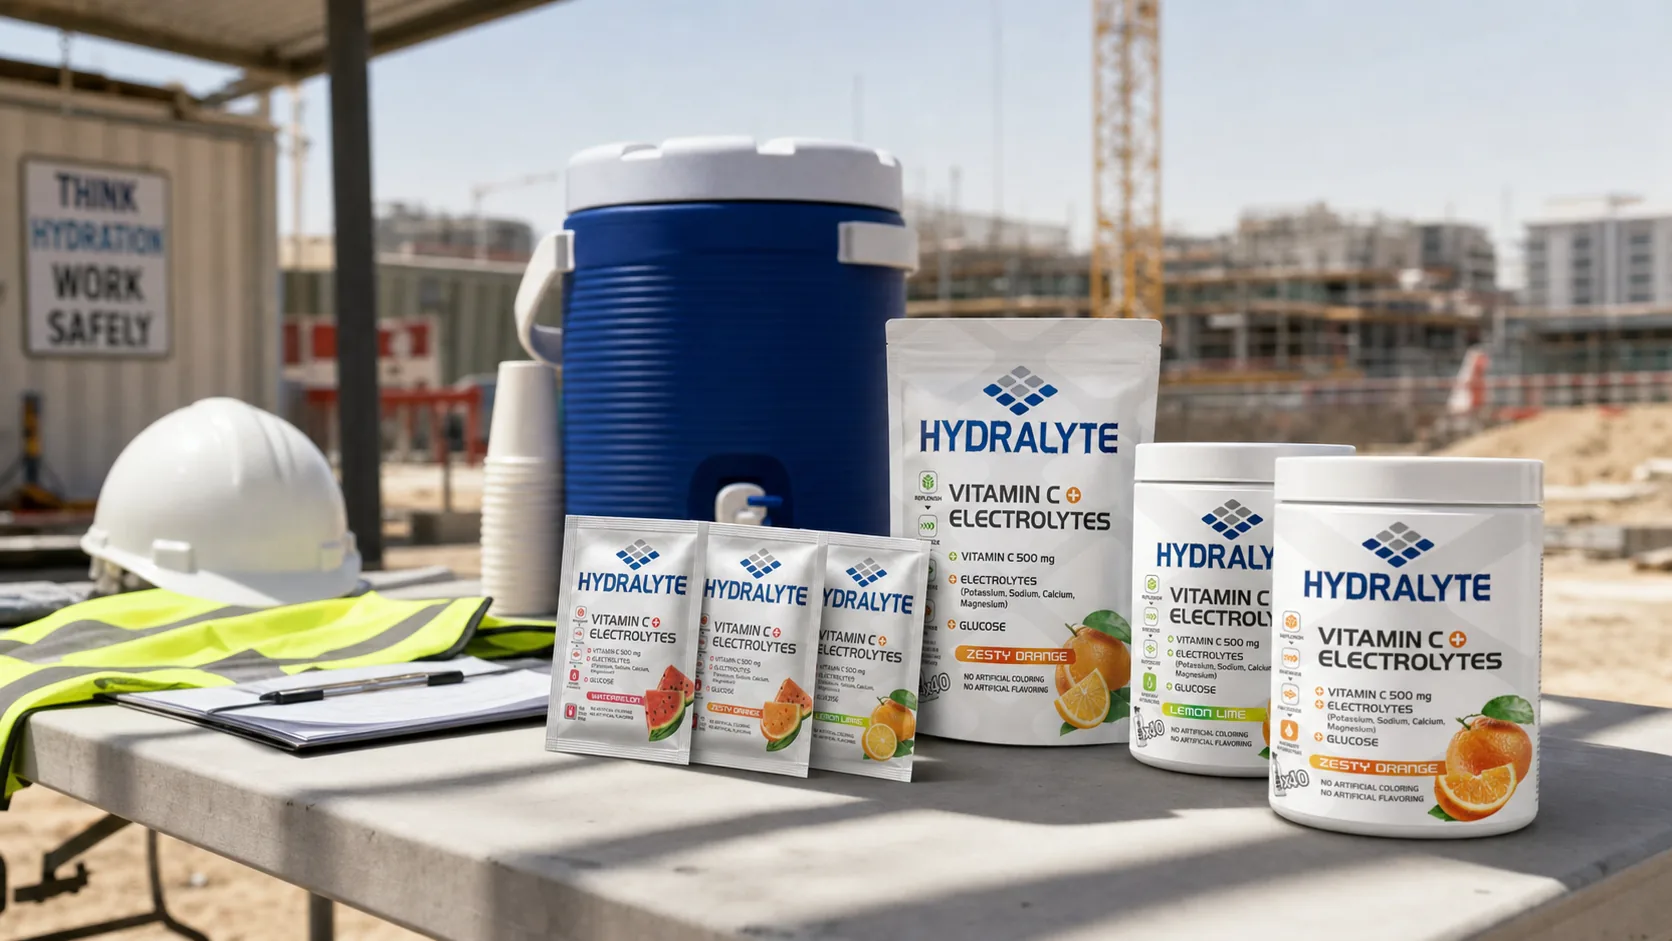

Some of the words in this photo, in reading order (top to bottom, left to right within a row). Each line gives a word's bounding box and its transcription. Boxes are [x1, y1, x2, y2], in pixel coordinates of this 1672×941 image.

[55, 172, 138, 212] THINK
[32, 219, 162, 256] HYDRATION
[51, 262, 146, 301] WORK
[47, 308, 154, 347] SAFELY
[920, 420, 1118, 454] HYDRALYTE
[949, 484, 1040, 504] VITAMIN
[1046, 486, 1060, 504] C
[950, 510, 1110, 530] ELECTROLYTES
[962, 552, 1004, 562] VITAMIN
[1007, 553, 1014, 563] C
[1016, 554, 1038, 563] 500
[1040, 556, 1054, 565] mg
[1156, 542, 1274, 570] HYDRALY
[578, 572, 688, 595] HYDRALYTE
[960, 575, 1037, 586] ELECTROLYTES
[1304, 570, 1490, 602] HYDRALYTE
[704, 578, 808, 606] HYDRALYTE
[961, 588, 1008, 598] (Potassium,
[1009, 590, 1040, 598] Sodium,
[1042, 590, 1075, 600] Calcium,
[1170, 587, 1251, 606] VITAMIN
[1256, 590, 1270, 606] C
[824, 588, 914, 614] YDRALYTE
[960, 600, 1008, 609] Magnesium)
[592, 614, 640, 628] VITAMIN
[642, 616, 650, 628] C
[960, 621, 1006, 632] GLUCOSE
[590, 628, 676, 644] ELECTROLYTES
[714, 622, 760, 636] VITAMIN
[763, 626, 772, 637] C
[712, 636, 796, 654] ELECTROLYTES
[820, 630, 866, 644] VITAMIN
[868, 635, 876, 646] C
[1176, 636, 1214, 646] VITAMIN
[1224, 638, 1244, 647] 500
[1246, 640, 1260, 649] mg
[1318, 627, 1422, 648] VITAMIN
[1428, 631, 1444, 648] C
[818, 644, 902, 664] ELECTROLYTES
[966, 649, 1010, 660] ZESTY
[1016, 651, 1068, 662] ORANGE
[1176, 650, 1244, 660] ELECTROLYTES
[1318, 650, 1502, 670] ELECTROLYTES
[964, 673, 974, 681] NO
[976, 674, 1010, 682] ARTIFICIAL
[1012, 675, 1044, 684] COLORING
[974, 684, 1010, 693] ARTIFICIAL
[1012, 686, 1048, 694] FLAVORING
[1175, 683, 1216, 694] GLUCOSE
[1328, 688, 1376, 700] VITAMIN
[1380, 690, 1386, 700] C
[1389, 691, 1413, 700] 500
[1416, 694, 1432, 702] mg
[1170, 705, 1212, 718] LEMON
[1216, 710, 1246, 720] LIME
[1328, 702, 1413, 714] ELECTROLYTES
[1328, 713, 1374, 724] (Potassium,
[1377, 717, 1410, 726] Sodium,
[1412, 718, 1446, 726] Calcium,
[1327, 722, 1376, 734] Magnesium)
[1326, 734, 1378, 747] GLUCOSE
[1320, 758, 1370, 772] ZESTY
[1376, 763, 1438, 774] ORANGE
[1334, 780, 1377, 792] ARTIFICIAL
[1379, 784, 1420, 792] COLORING
[1334, 790, 1376, 802] ARTIFICIAL
[1378, 794, 1424, 802] FLAVORING
